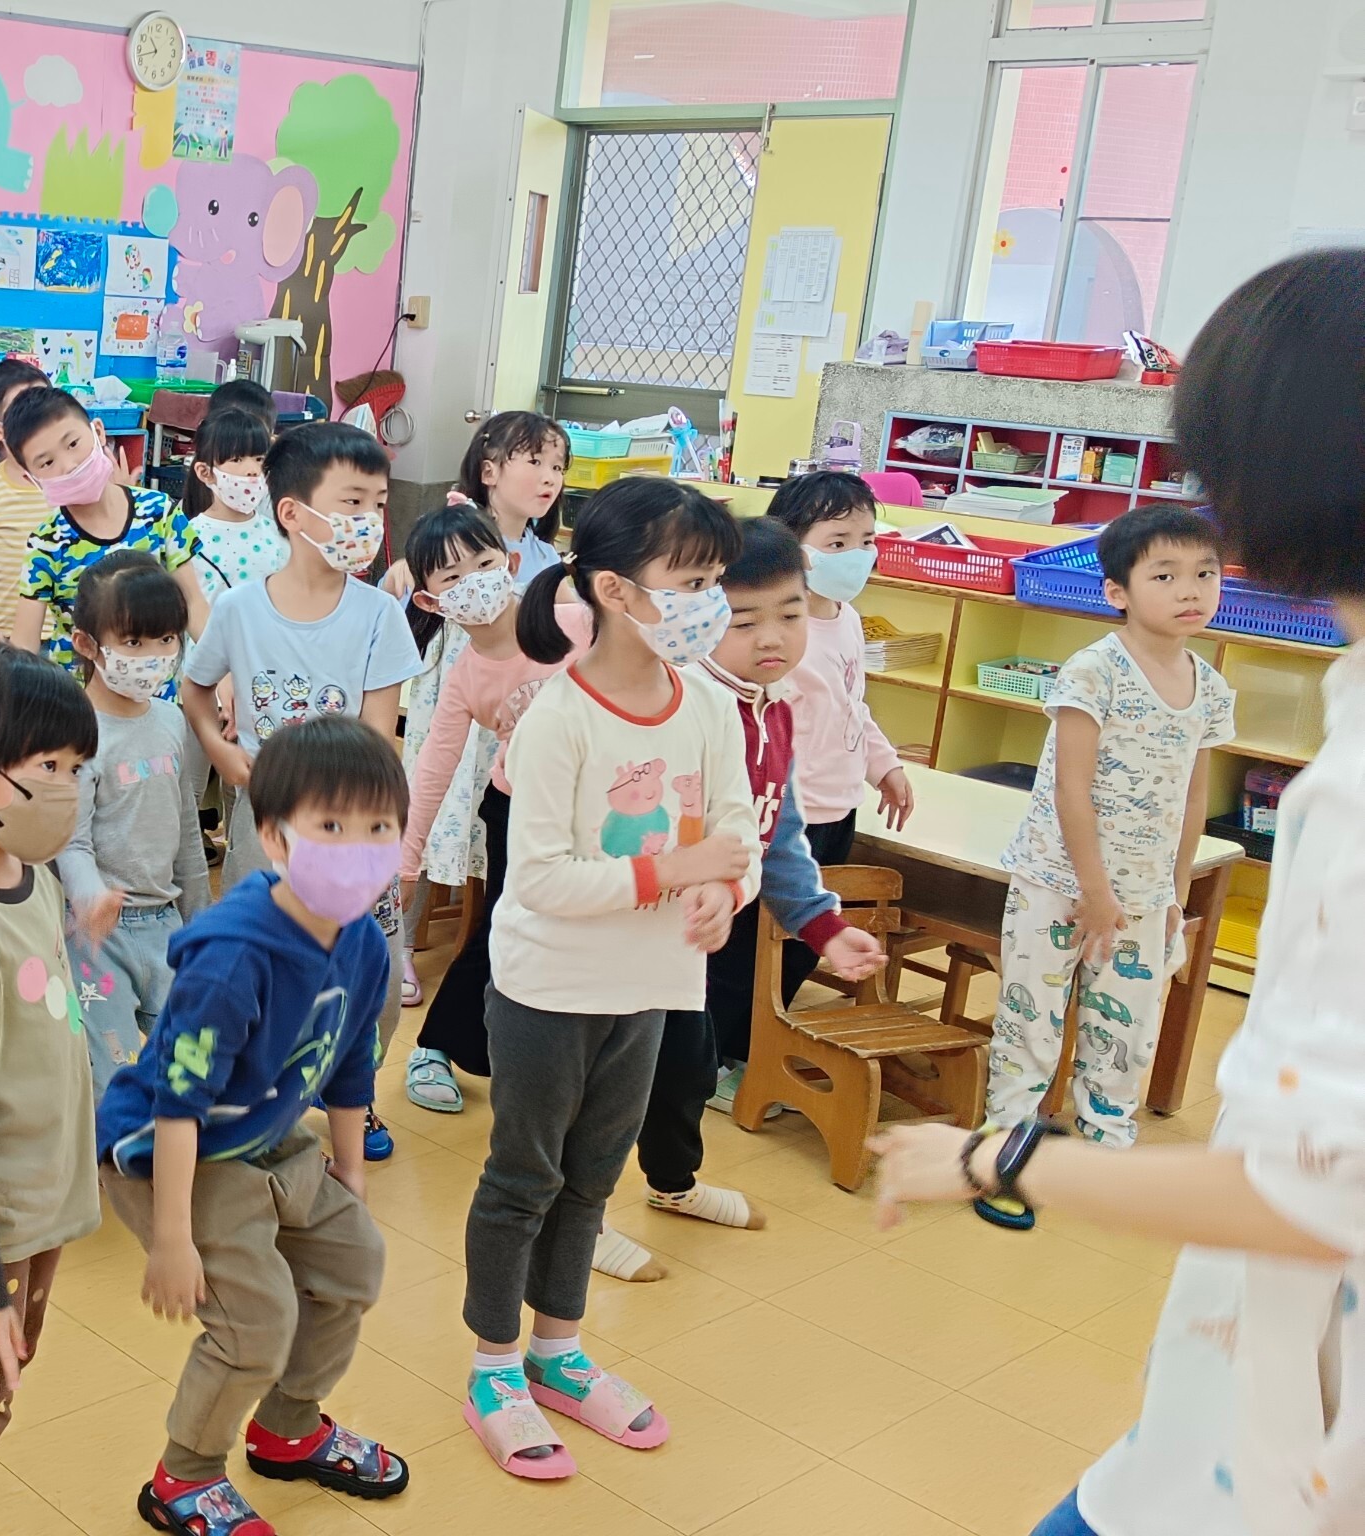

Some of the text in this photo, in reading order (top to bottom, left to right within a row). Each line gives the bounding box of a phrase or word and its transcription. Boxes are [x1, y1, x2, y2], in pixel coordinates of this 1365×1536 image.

[155, 24, 163, 33] 12
[140, 34, 147, 43] 10
[169, 37, 175, 46] 2
[136, 44, 142, 54] 9
[170, 49, 176, 58] 3
[138, 57, 143, 66] 8
[167, 61, 172, 69] 4
[143, 66, 149, 75] 7
[151, 70, 157, 79] 6
[160, 68, 165, 77] 5
